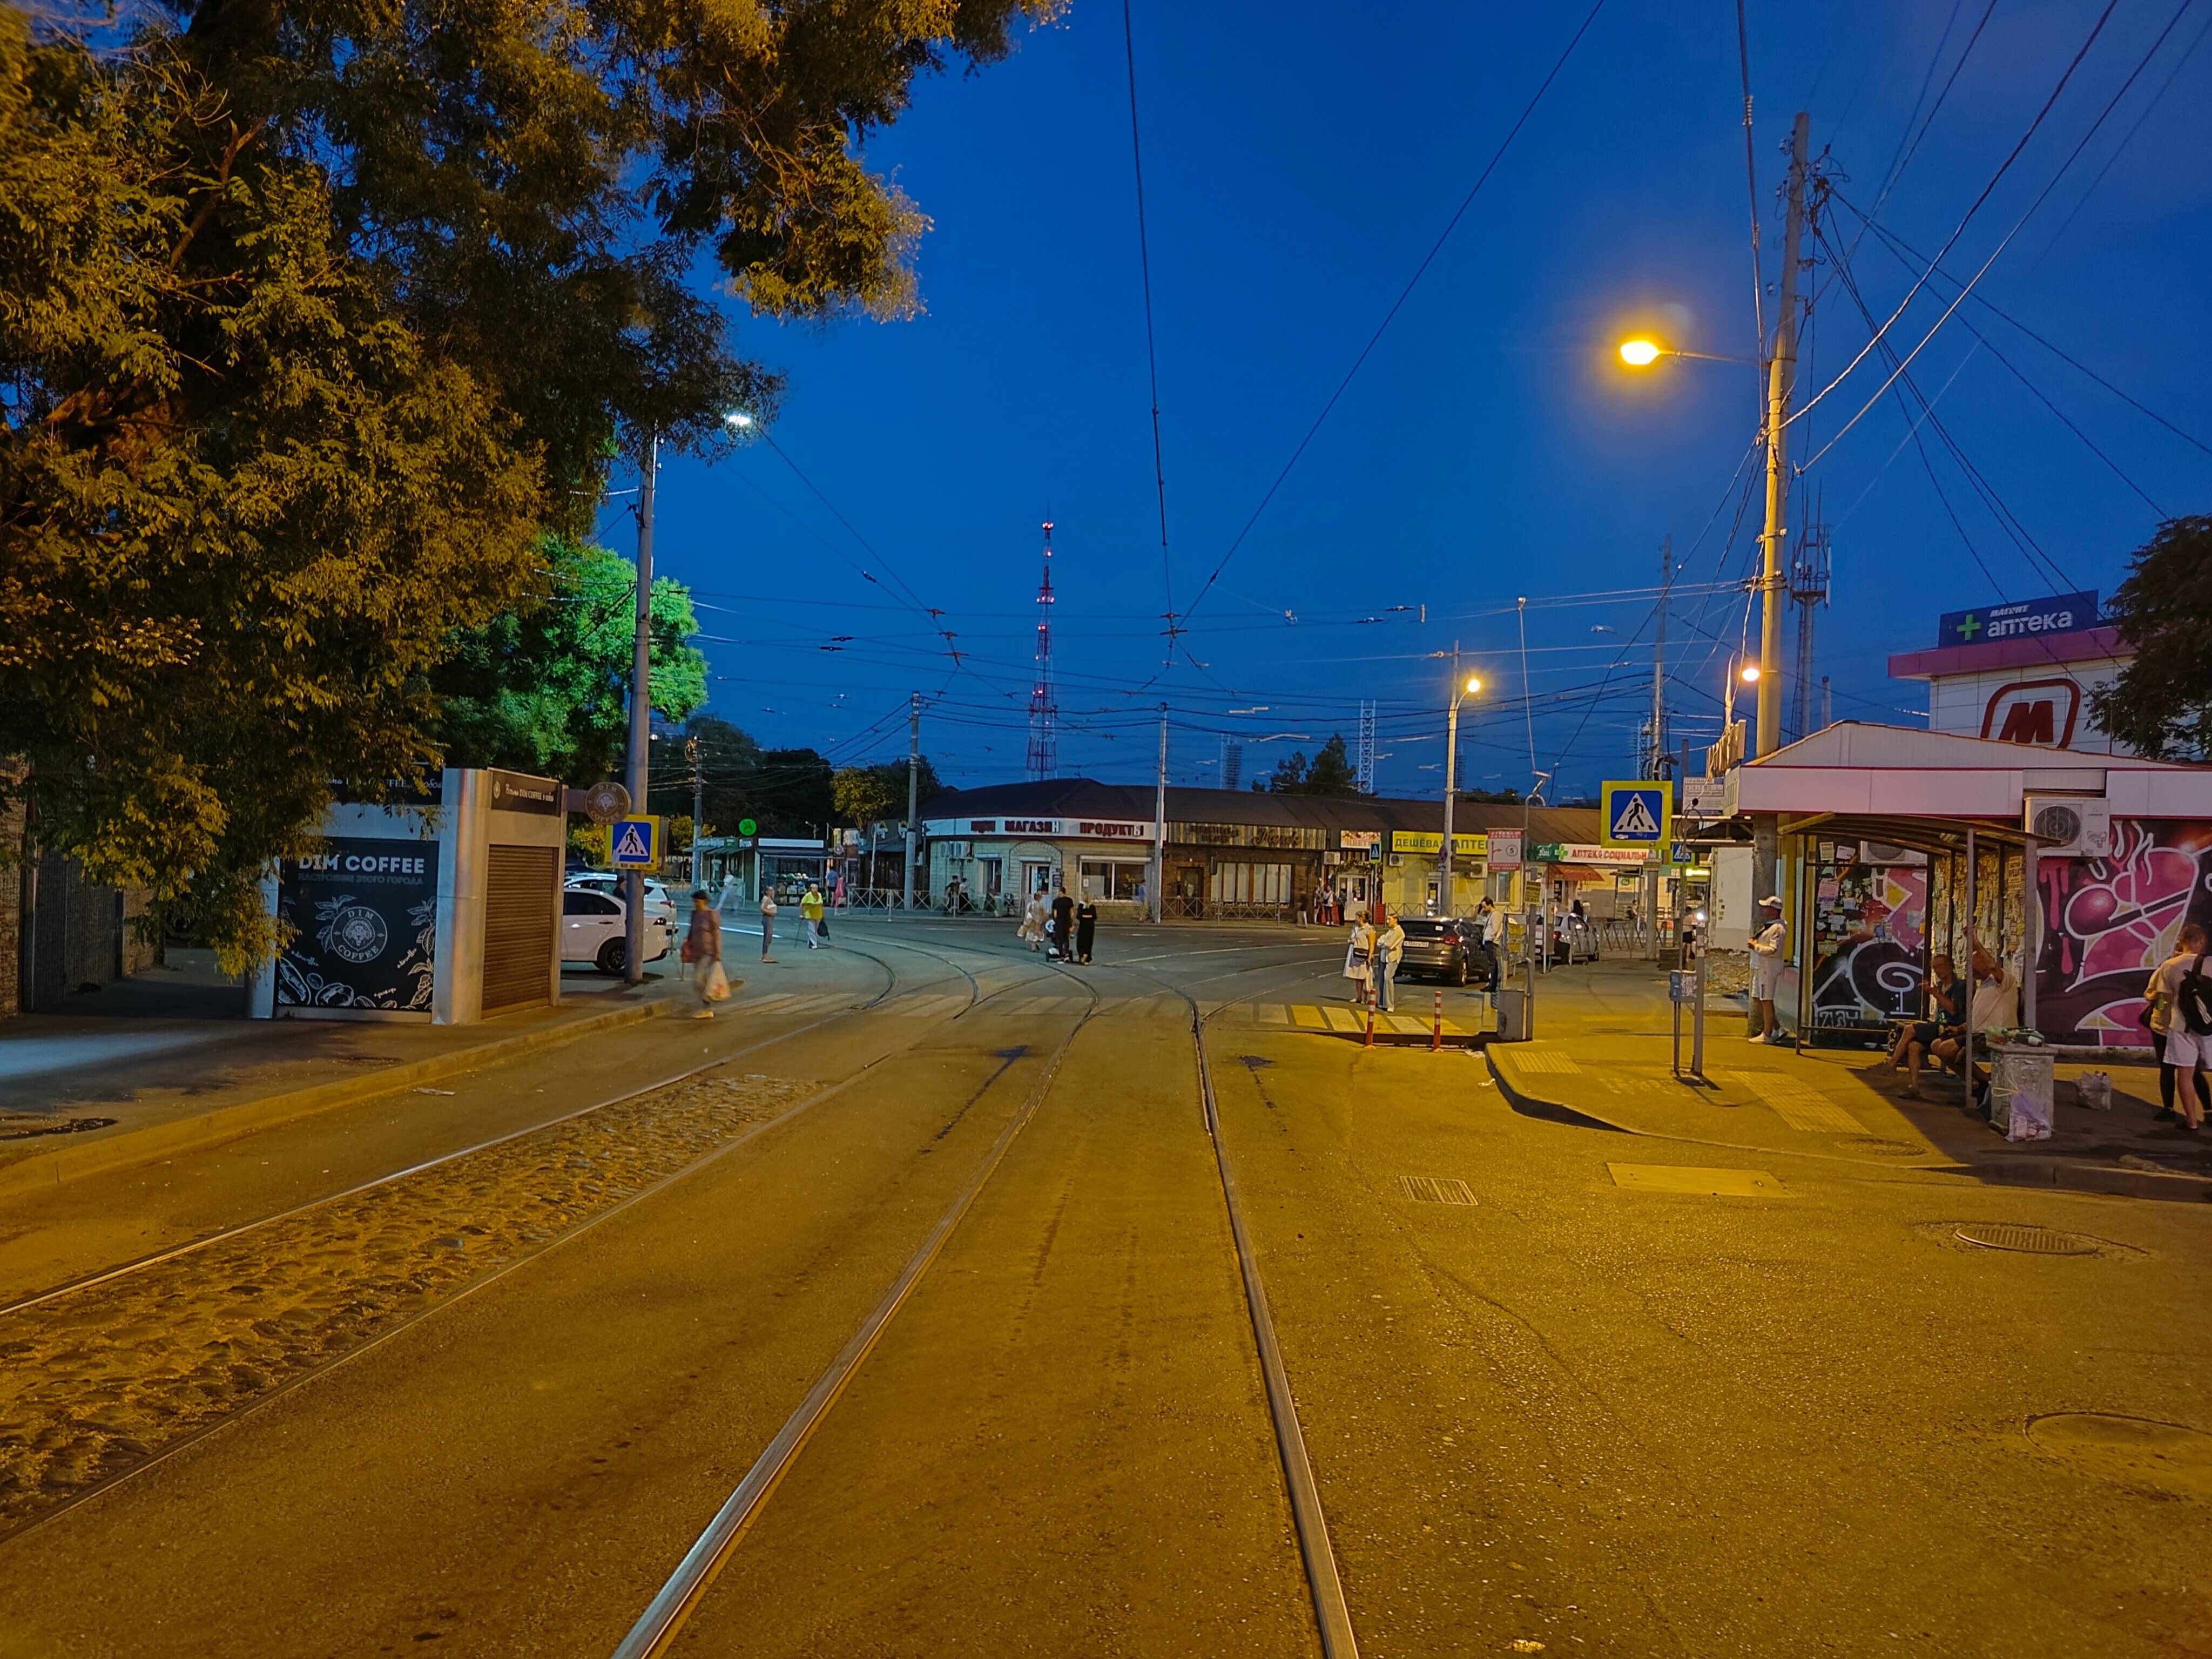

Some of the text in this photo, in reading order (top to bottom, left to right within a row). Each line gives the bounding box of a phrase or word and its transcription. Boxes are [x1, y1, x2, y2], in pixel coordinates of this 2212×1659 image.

[1987, 611, 2072, 637] аптека
[528, 790, 542, 800] COFFEE
[1004, 820, 1060, 833] МАГАЗИН
[1080, 822, 1144, 837] ПРОДУКТЫ
[1394, 838, 1445, 849] ДЕШЁВА
[1604, 851, 1647, 860] СОЦИАЛЬН
[299, 854, 425, 874] DIM COFFEE
[356, 874, 385, 884] ЭТОГО
[387, 876, 423, 886] ГОРОДА
[347, 909, 375, 920] DIM
[338, 945, 379, 960] COFFEE
